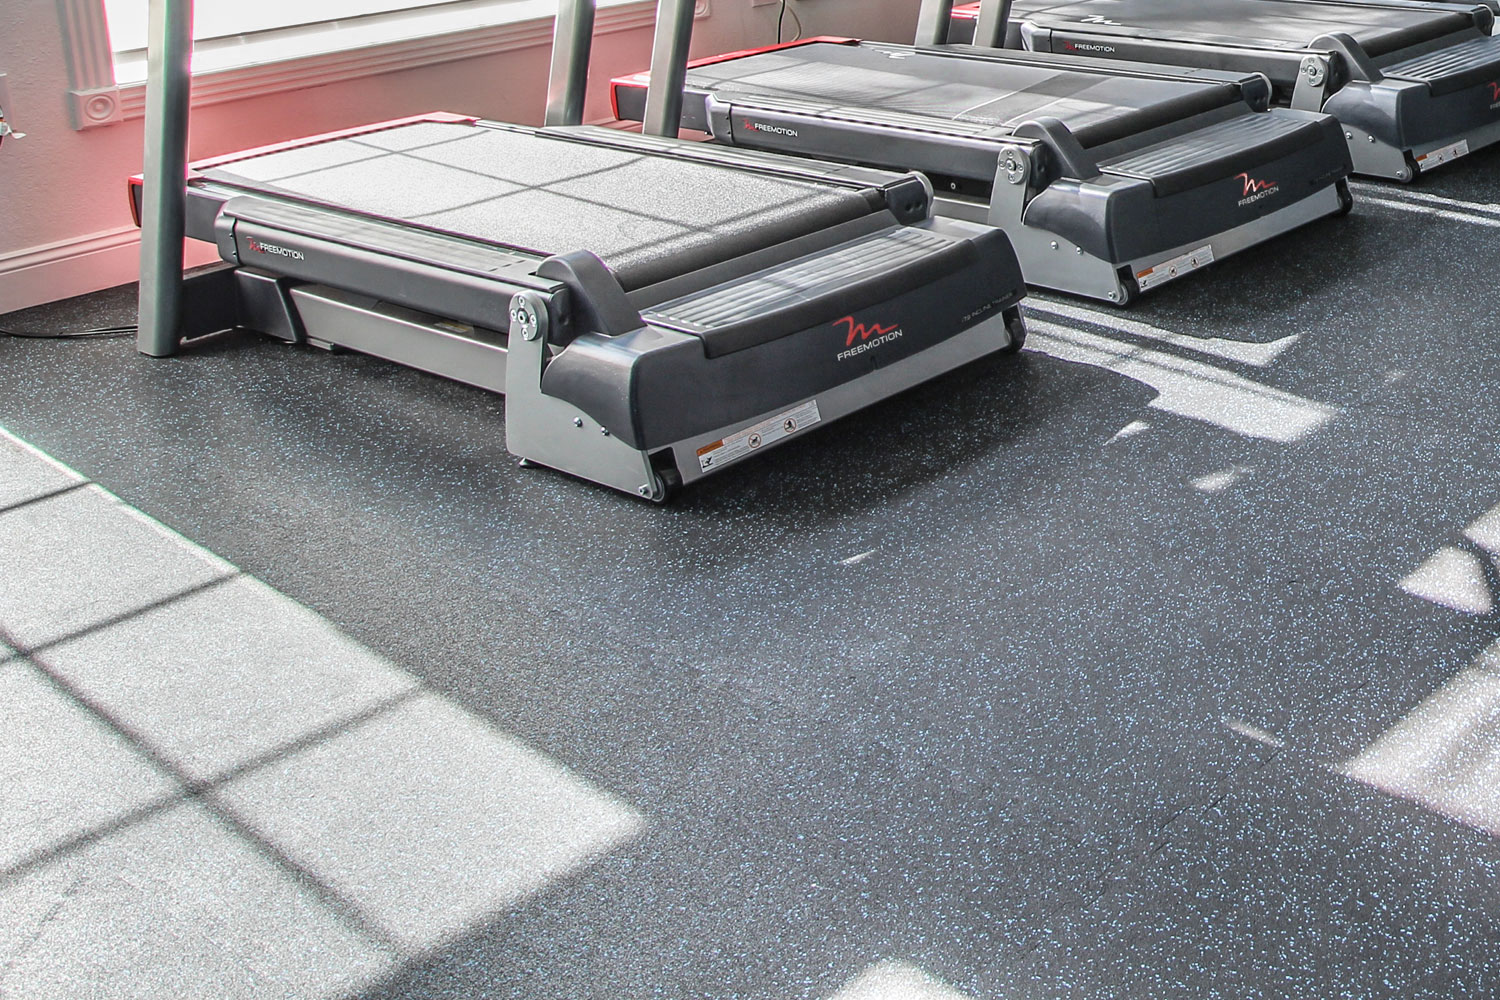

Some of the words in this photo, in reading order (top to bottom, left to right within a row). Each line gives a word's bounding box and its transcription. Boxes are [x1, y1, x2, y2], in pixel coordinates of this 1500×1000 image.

[1074, 43, 1115, 53] FREEMOTION
[754, 122, 798, 137] FREEMOTION
[1238, 185, 1279, 207] FREEMOTION
[259, 241, 305, 261] FREEMOTION
[837, 329, 903, 361] FREEMOTION
